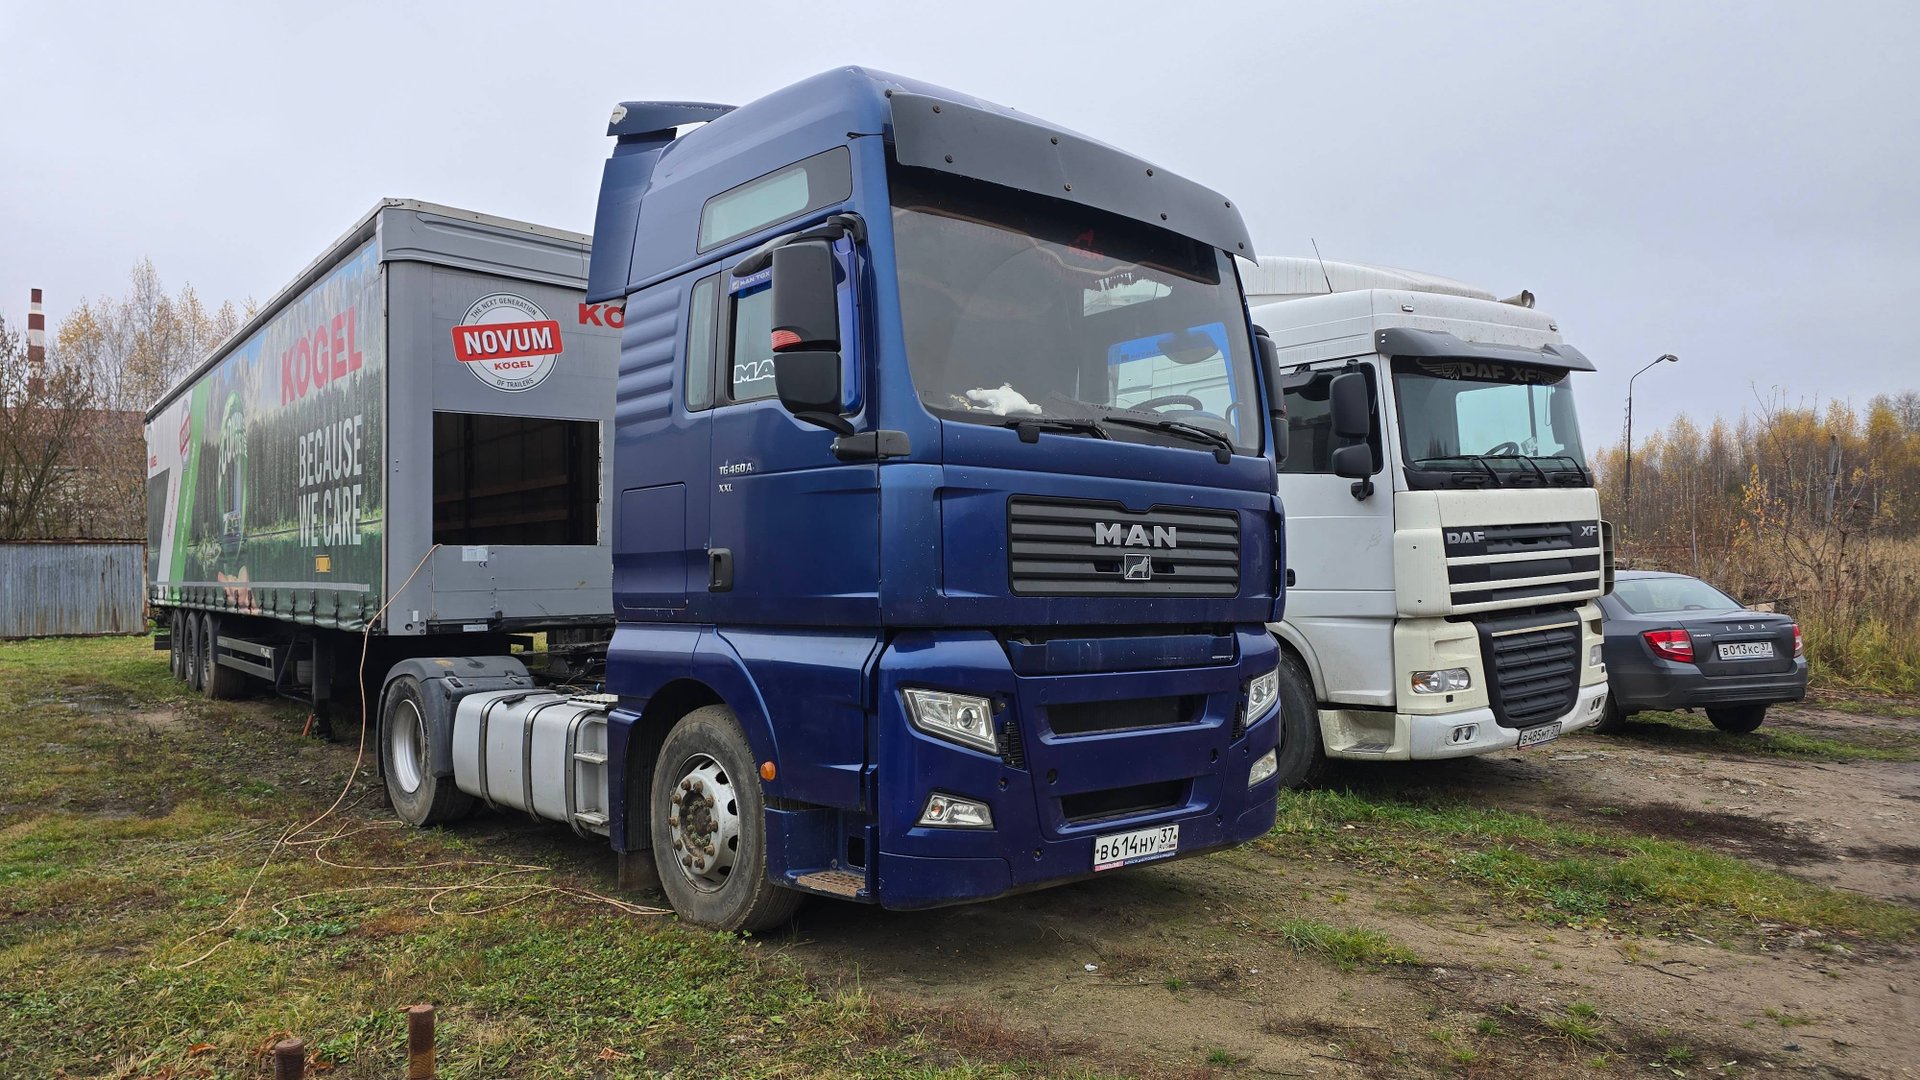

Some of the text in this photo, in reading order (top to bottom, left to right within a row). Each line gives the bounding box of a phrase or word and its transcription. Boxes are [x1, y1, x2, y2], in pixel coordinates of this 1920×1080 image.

[470, 298, 537, 318] THE NEXT GENERATION
[463, 327, 553, 355] NOVUM
[1460, 362, 1537, 382] DAF XF
[496, 378, 534, 387] OF TRAILERS
[299, 414, 362, 488] BECAUSE
[718, 484, 733, 493] XXL
[299, 484, 362, 548] WE CARE
[1095, 522, 1177, 549] MAN
[1447, 531, 1485, 544] DAF
[1580, 525, 1598, 537] XF
[1725, 623, 1766, 631] LADA
[1160, 827, 1175, 843] 37
